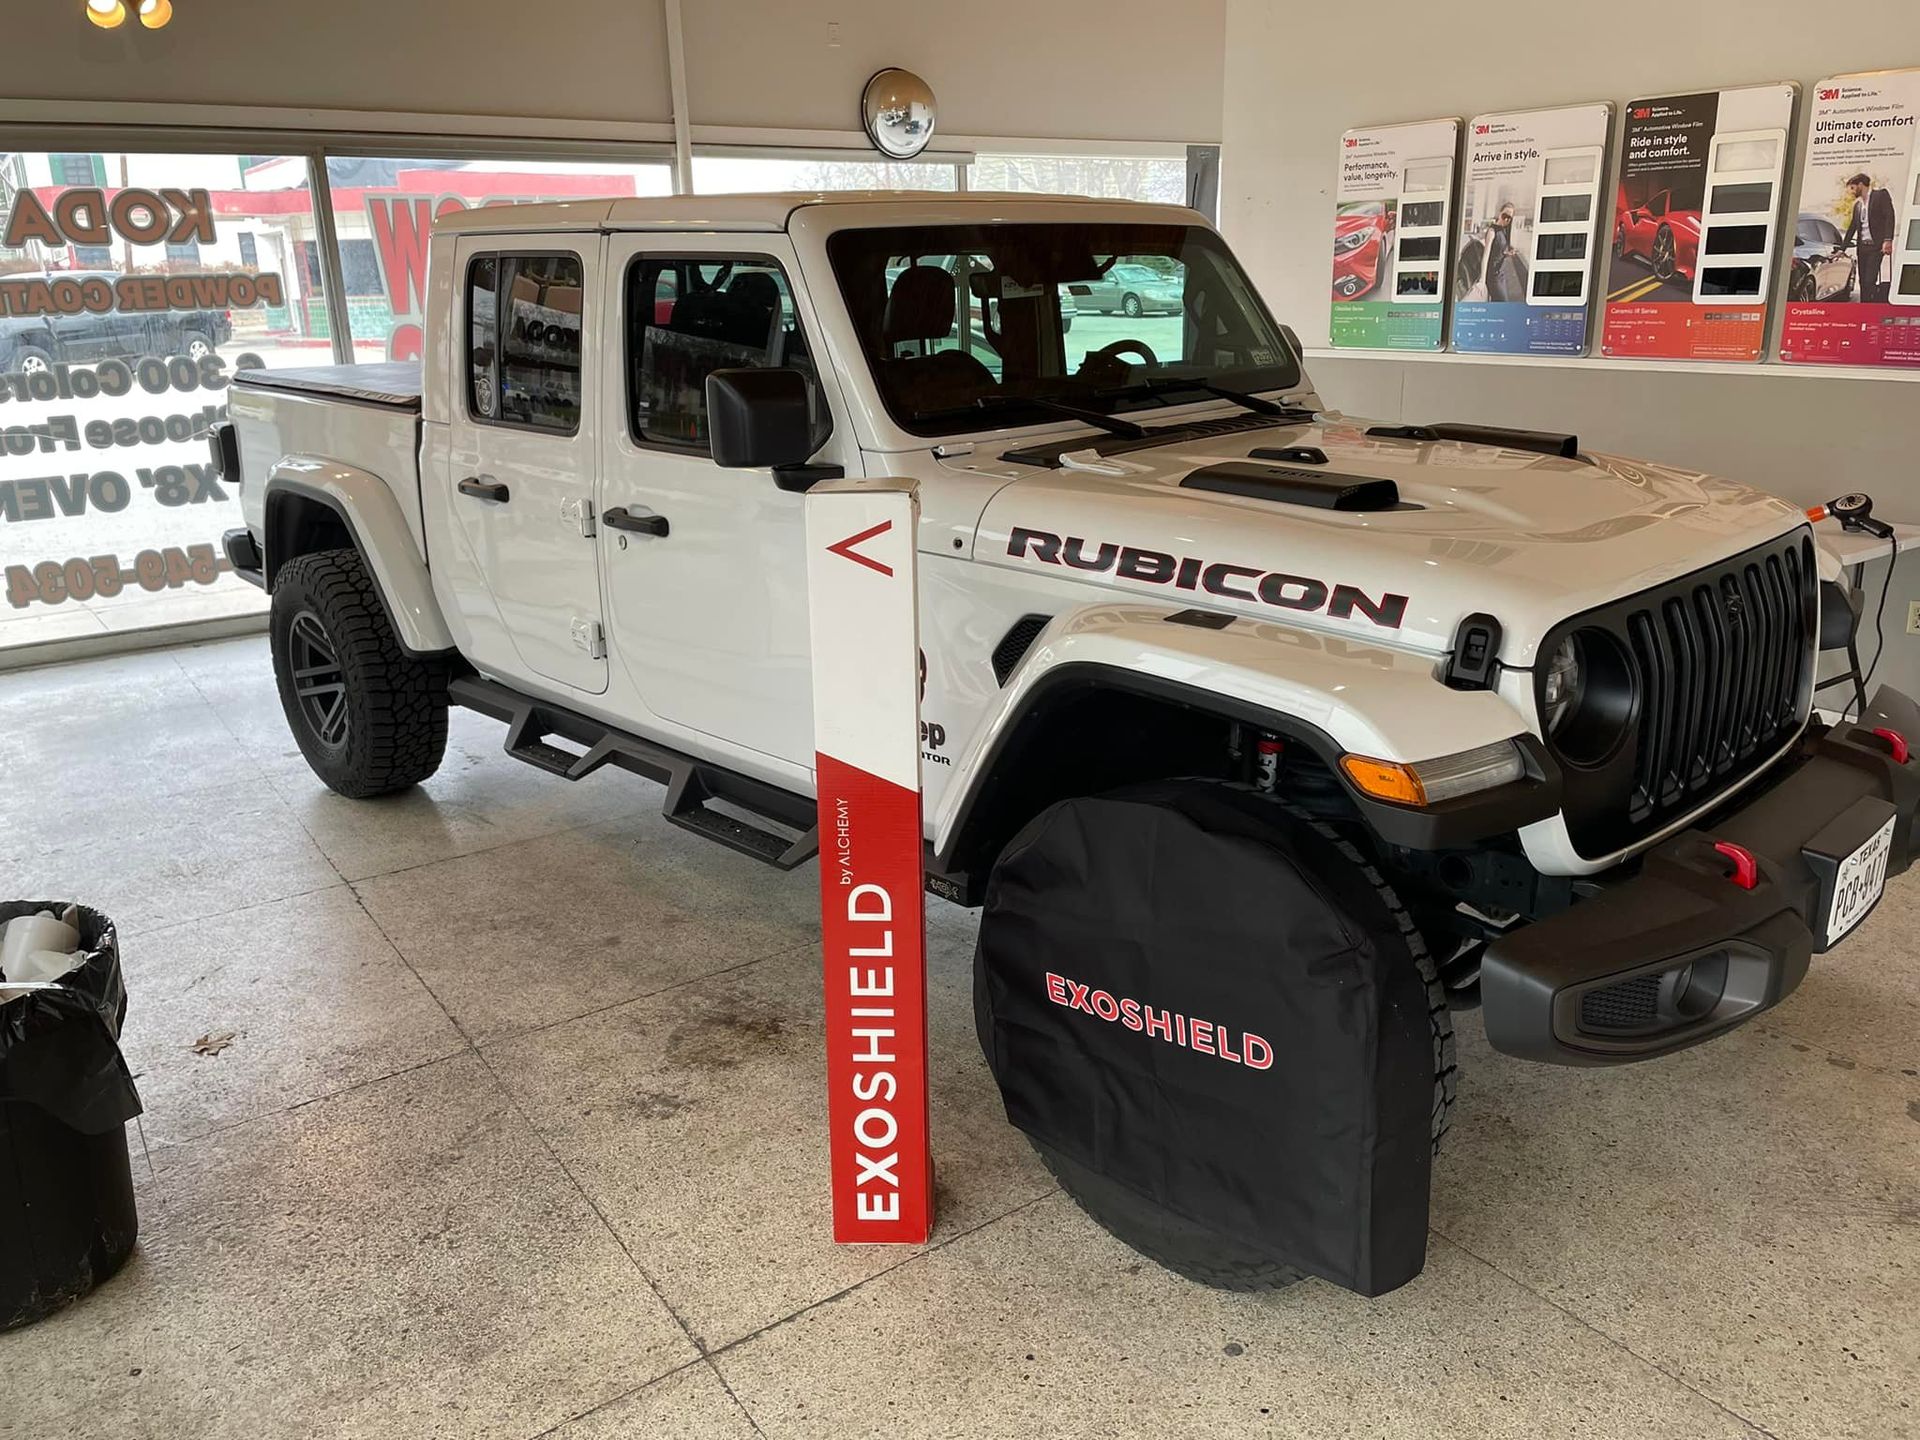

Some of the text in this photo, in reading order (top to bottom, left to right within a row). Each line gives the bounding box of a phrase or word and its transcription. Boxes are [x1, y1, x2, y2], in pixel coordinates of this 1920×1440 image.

[1820, 88, 1840, 100] 3M
[1633, 107, 1650, 119] 3M
[1475, 124, 1489, 134] 3M
[1816, 115, 1914, 132] Ultimate comfort
[1345, 138, 1358, 148] 3M
[1630, 134, 1688, 147] Ride in style
[1814, 131, 1876, 145] and clarity.
[1473, 148, 1540, 162] Arrive in style.
[1629, 146, 1690, 159] and comfort.
[1344, 161, 1389, 171] Performance,
[1343, 171, 1398, 182] value, longevity.
[1007, 526, 1410, 629] RUBICON
[836, 798, 853, 884] by ALCHEMY
[1858, 835, 1881, 866] TEXAS
[1046, 972, 1274, 1070] EXOSHIELD
[848, 884, 900, 1221] EXOSHIELD
